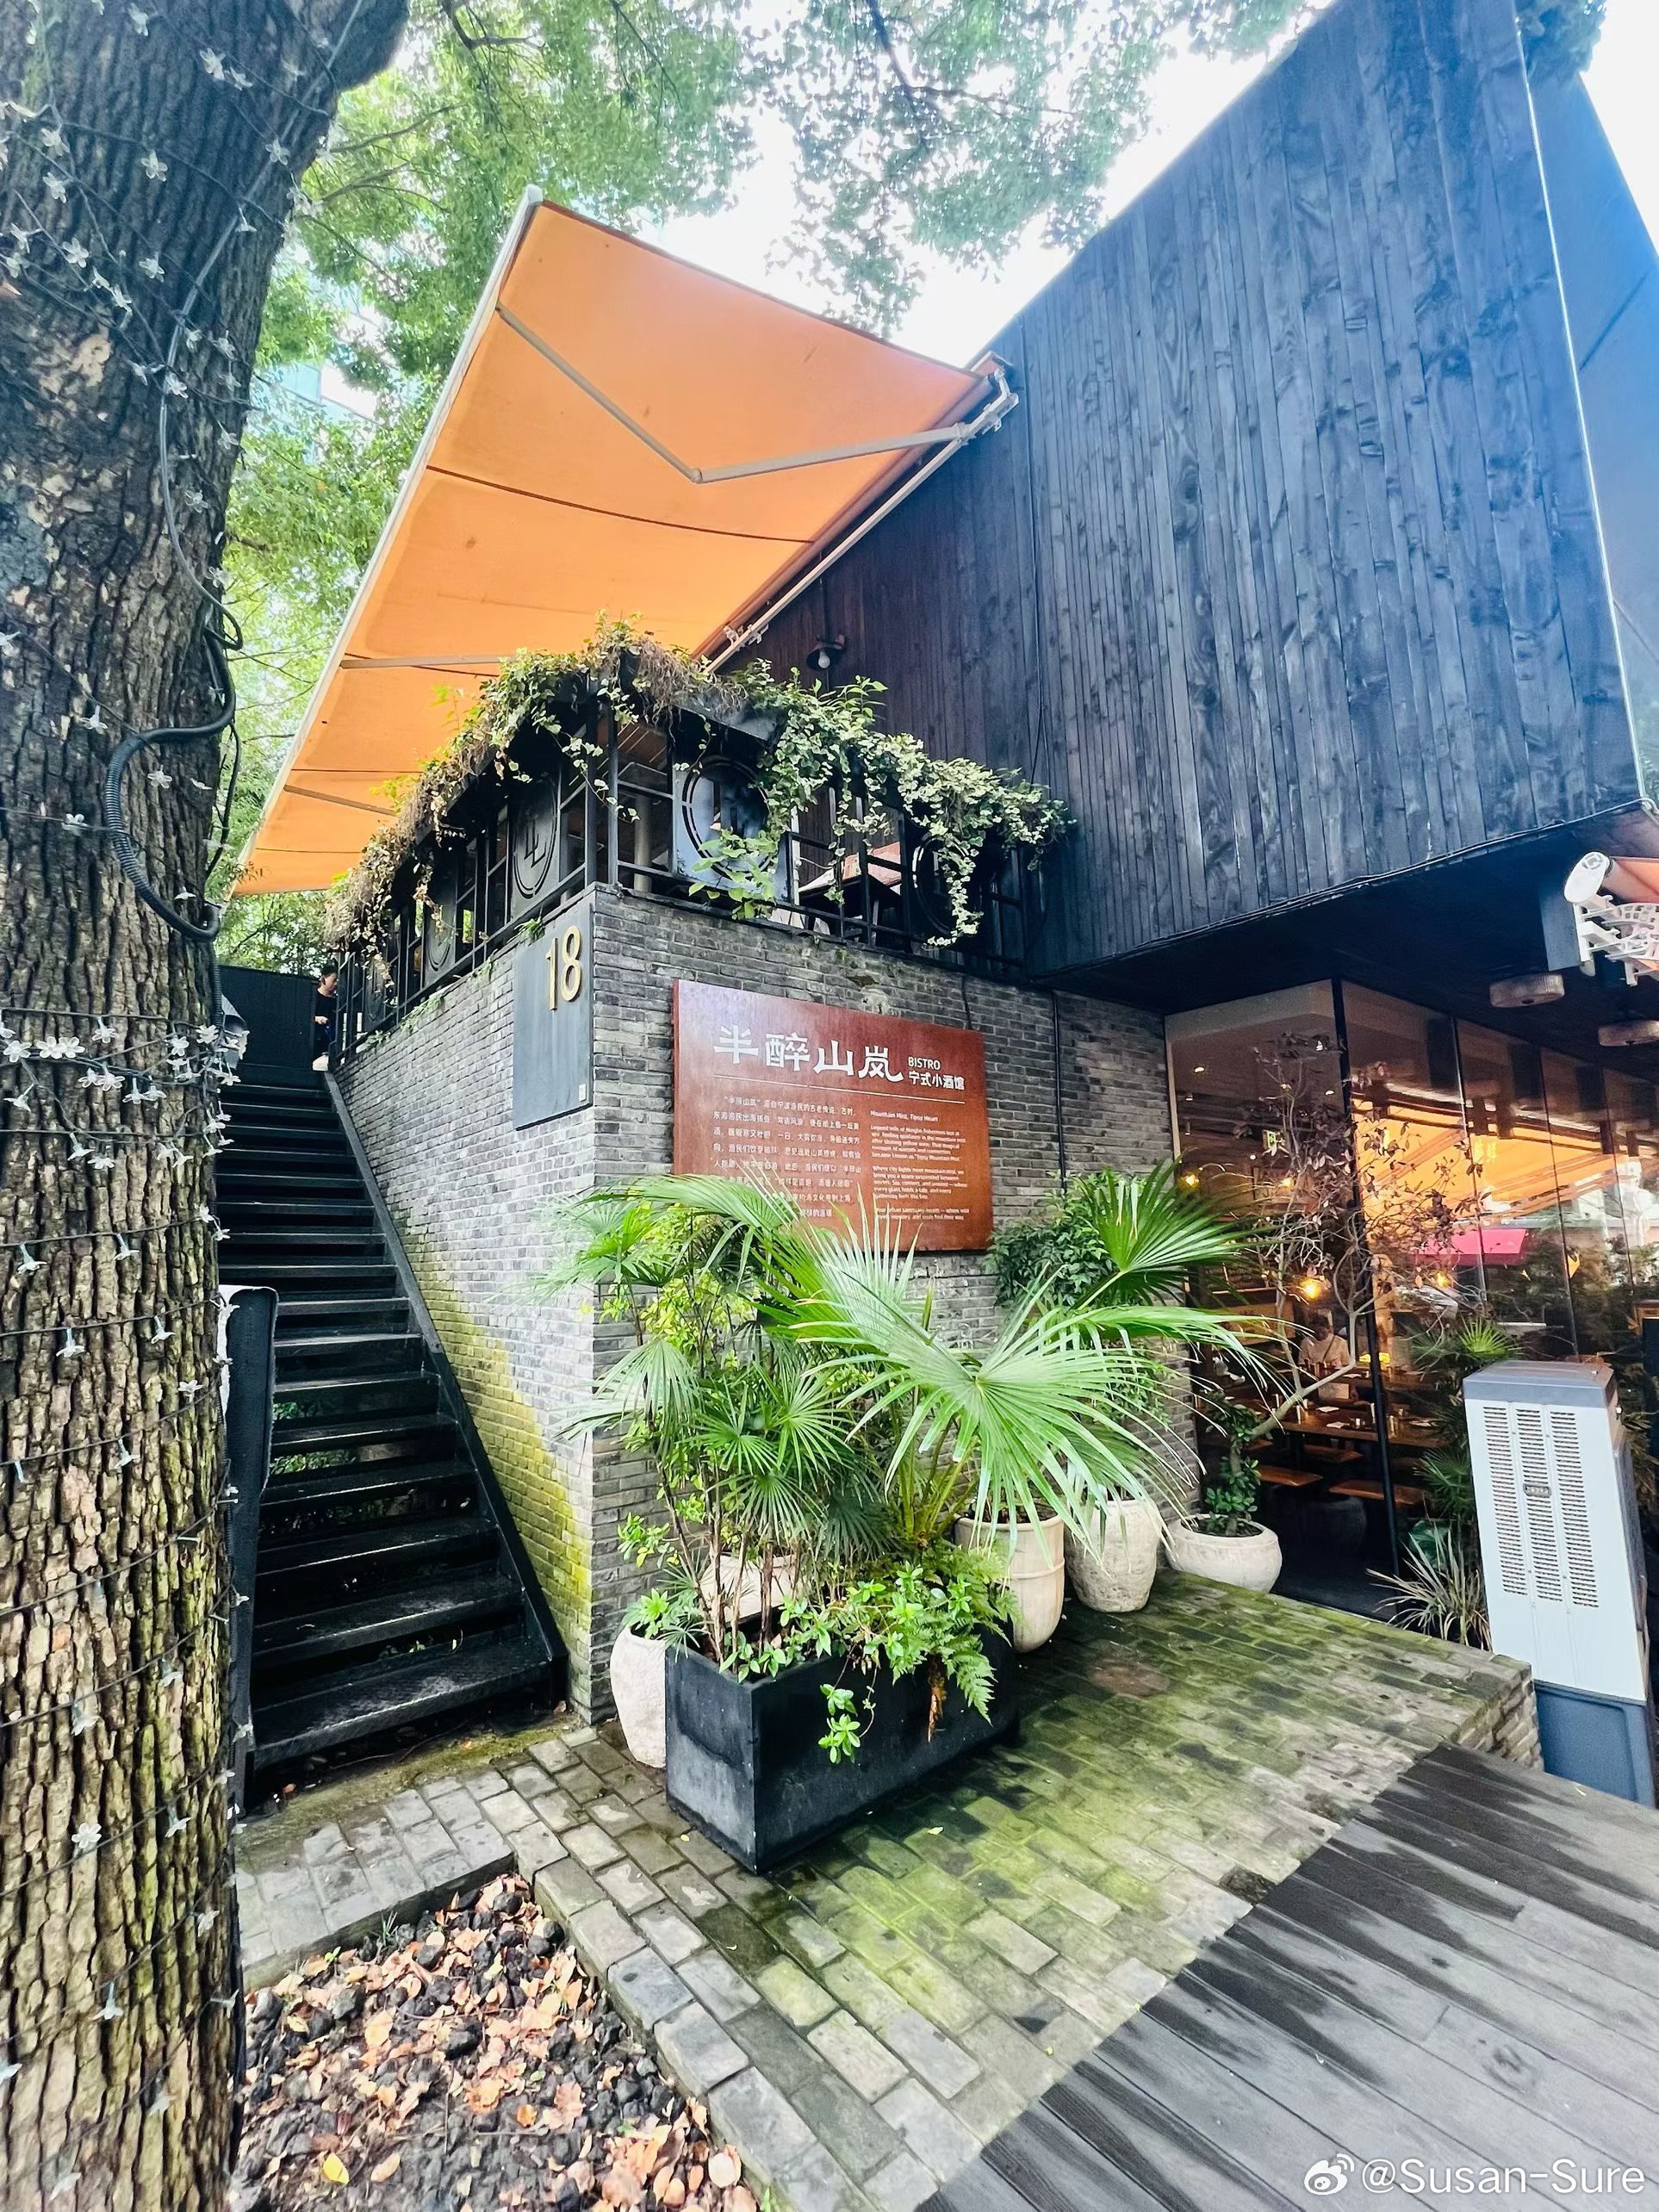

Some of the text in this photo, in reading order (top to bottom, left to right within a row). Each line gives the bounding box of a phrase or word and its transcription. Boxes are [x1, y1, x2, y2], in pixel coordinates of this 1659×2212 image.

[545, 925, 582, 1010] 18
[713, 1024, 904, 1083] 半醉山岚
[908, 1056, 941, 1071] BISTRO
[909, 1071, 965, 1090] 宁式小酒馆
